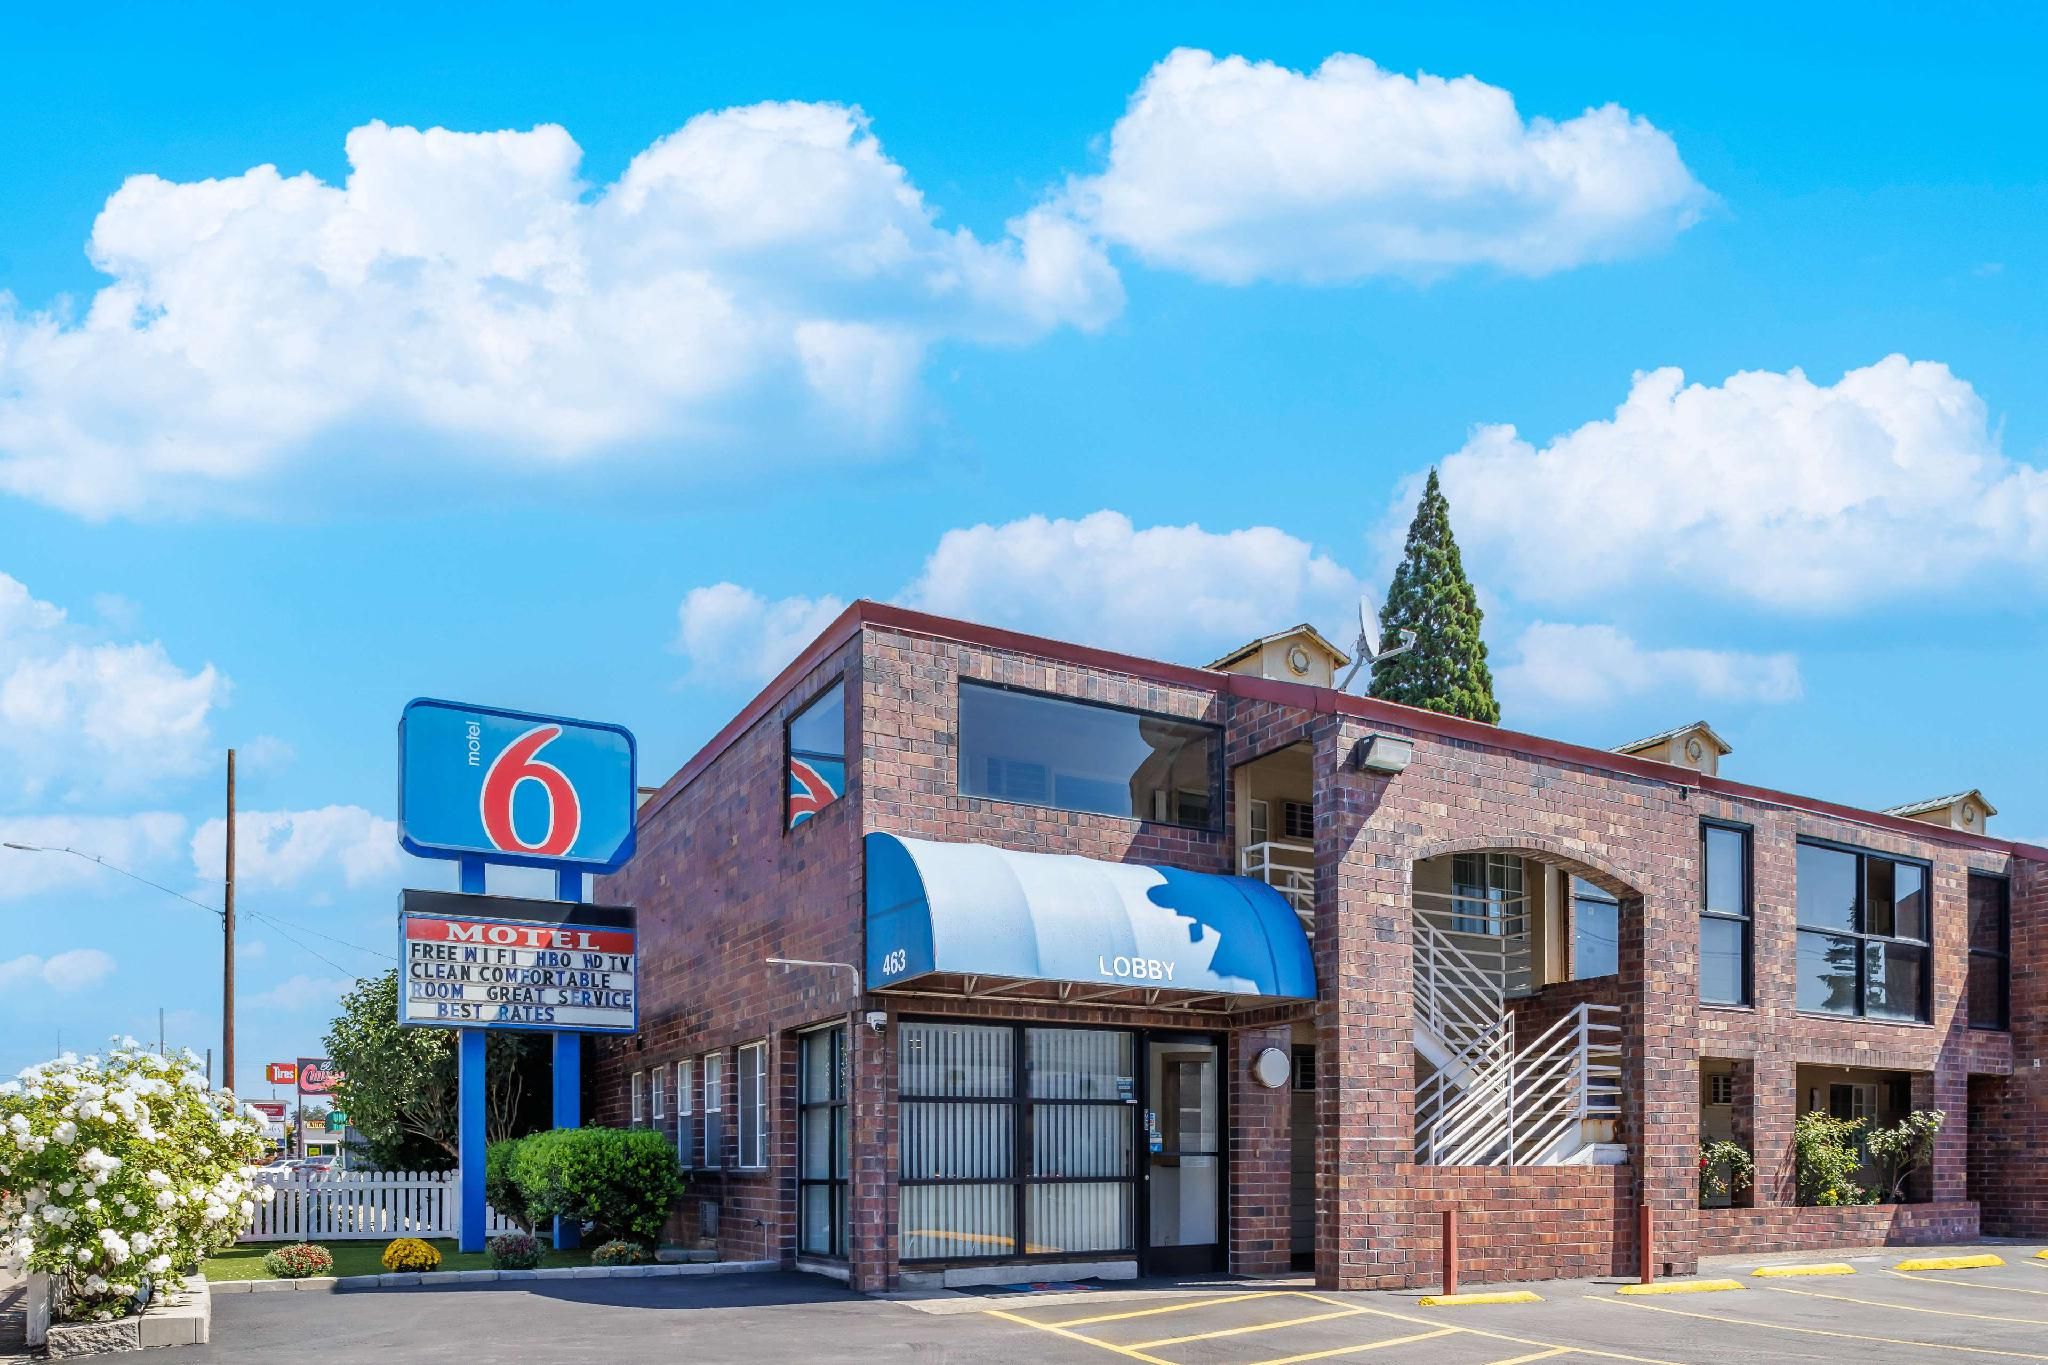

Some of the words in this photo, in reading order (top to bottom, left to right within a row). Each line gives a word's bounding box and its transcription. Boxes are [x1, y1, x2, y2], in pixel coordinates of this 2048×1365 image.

[468, 720, 480, 767] motel
[479, 723, 581, 857] 6
[446, 923, 600, 950] MOTEL
[411, 942, 457, 961] FREE
[536, 951, 571, 967] HBO
[882, 949, 906, 976] 463
[1098, 954, 1175, 981] LOBBY
[410, 962, 471, 981] CLEAN
[479, 966, 610, 988] COMFORTABLE
[412, 982, 464, 999] ROOM
[487, 985, 545, 1003] GREAT
[559, 989, 631, 1007] SERVICE
[438, 1001, 483, 1019] BEST
[500, 1004, 555, 1021] RATES
[273, 1066, 294, 1081] Tires
